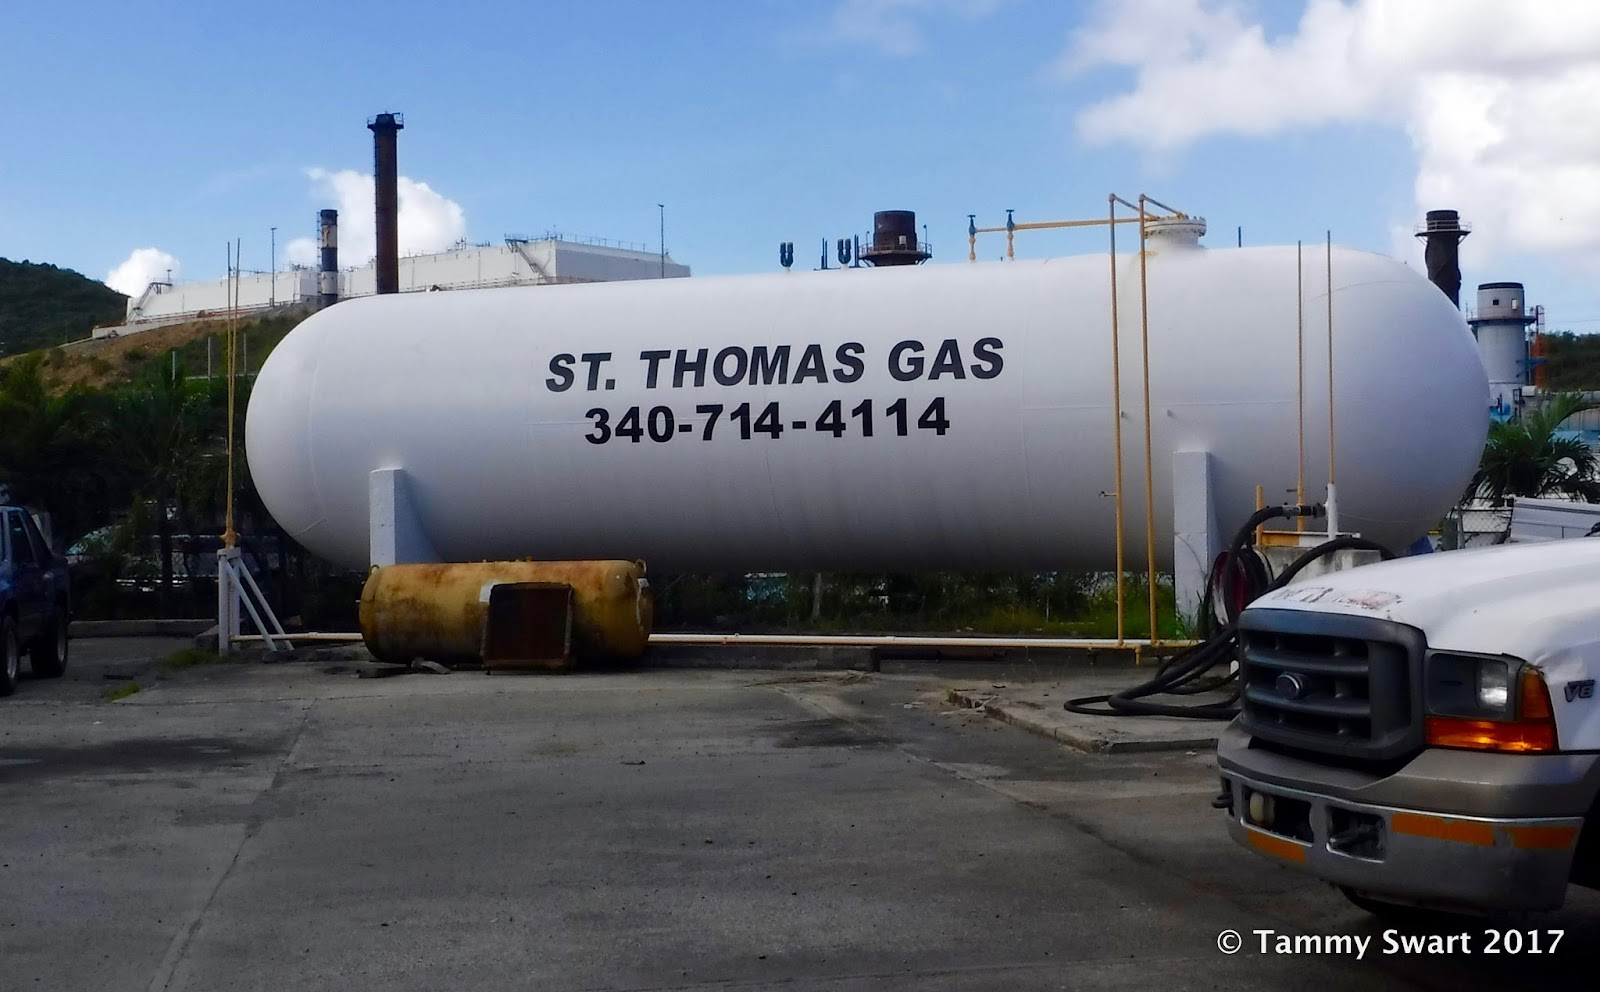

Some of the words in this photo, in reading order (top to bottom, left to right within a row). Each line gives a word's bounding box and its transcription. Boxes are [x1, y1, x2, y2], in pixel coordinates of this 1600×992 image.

[545, 352, 616, 393] ST.
[639, 341, 865, 389] THOMAS
[887, 337, 1005, 382] GAS
[584, 396, 951, 445] 340-714-4114
